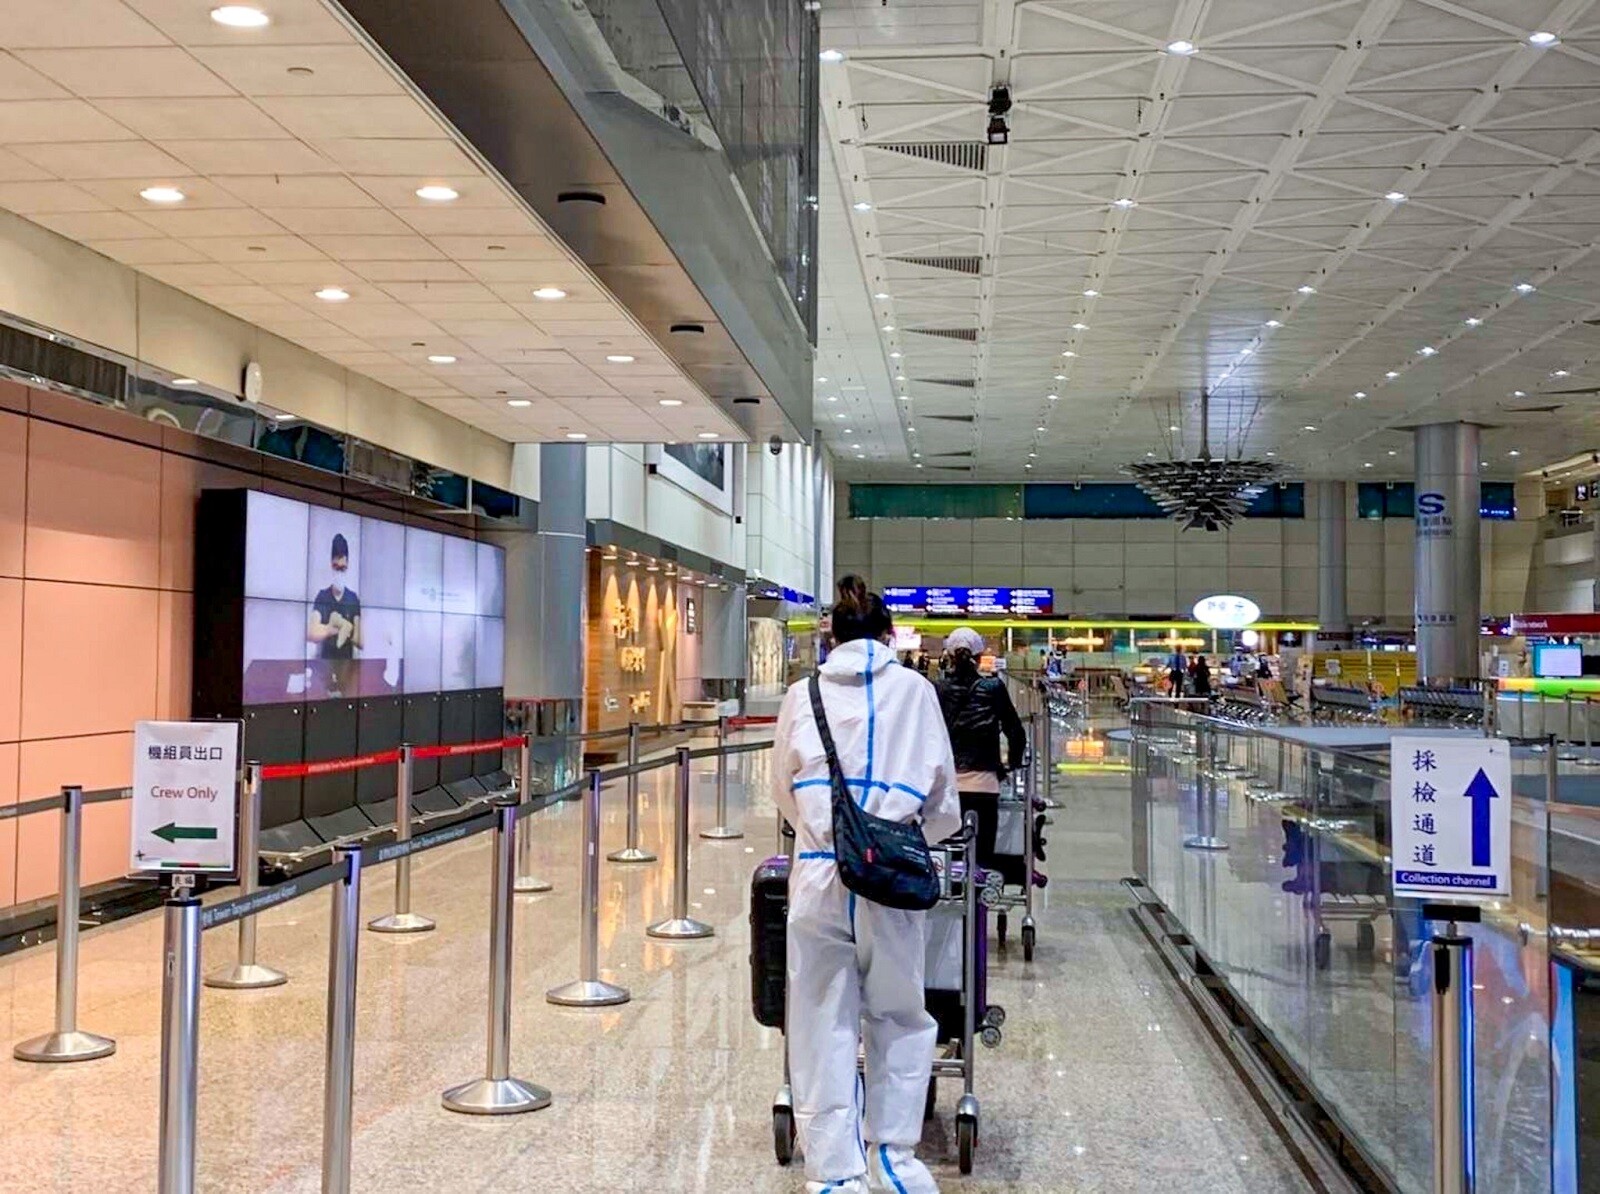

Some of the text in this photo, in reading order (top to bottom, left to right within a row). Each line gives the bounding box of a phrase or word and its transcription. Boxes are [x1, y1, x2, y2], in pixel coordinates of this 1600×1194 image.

[148, 745, 223, 761] 機組員出口
[150, 785, 219, 803] Crew Only
[1412, 749, 1438, 867] 採檢通道
[1401, 872, 1492, 887] Collection channel
